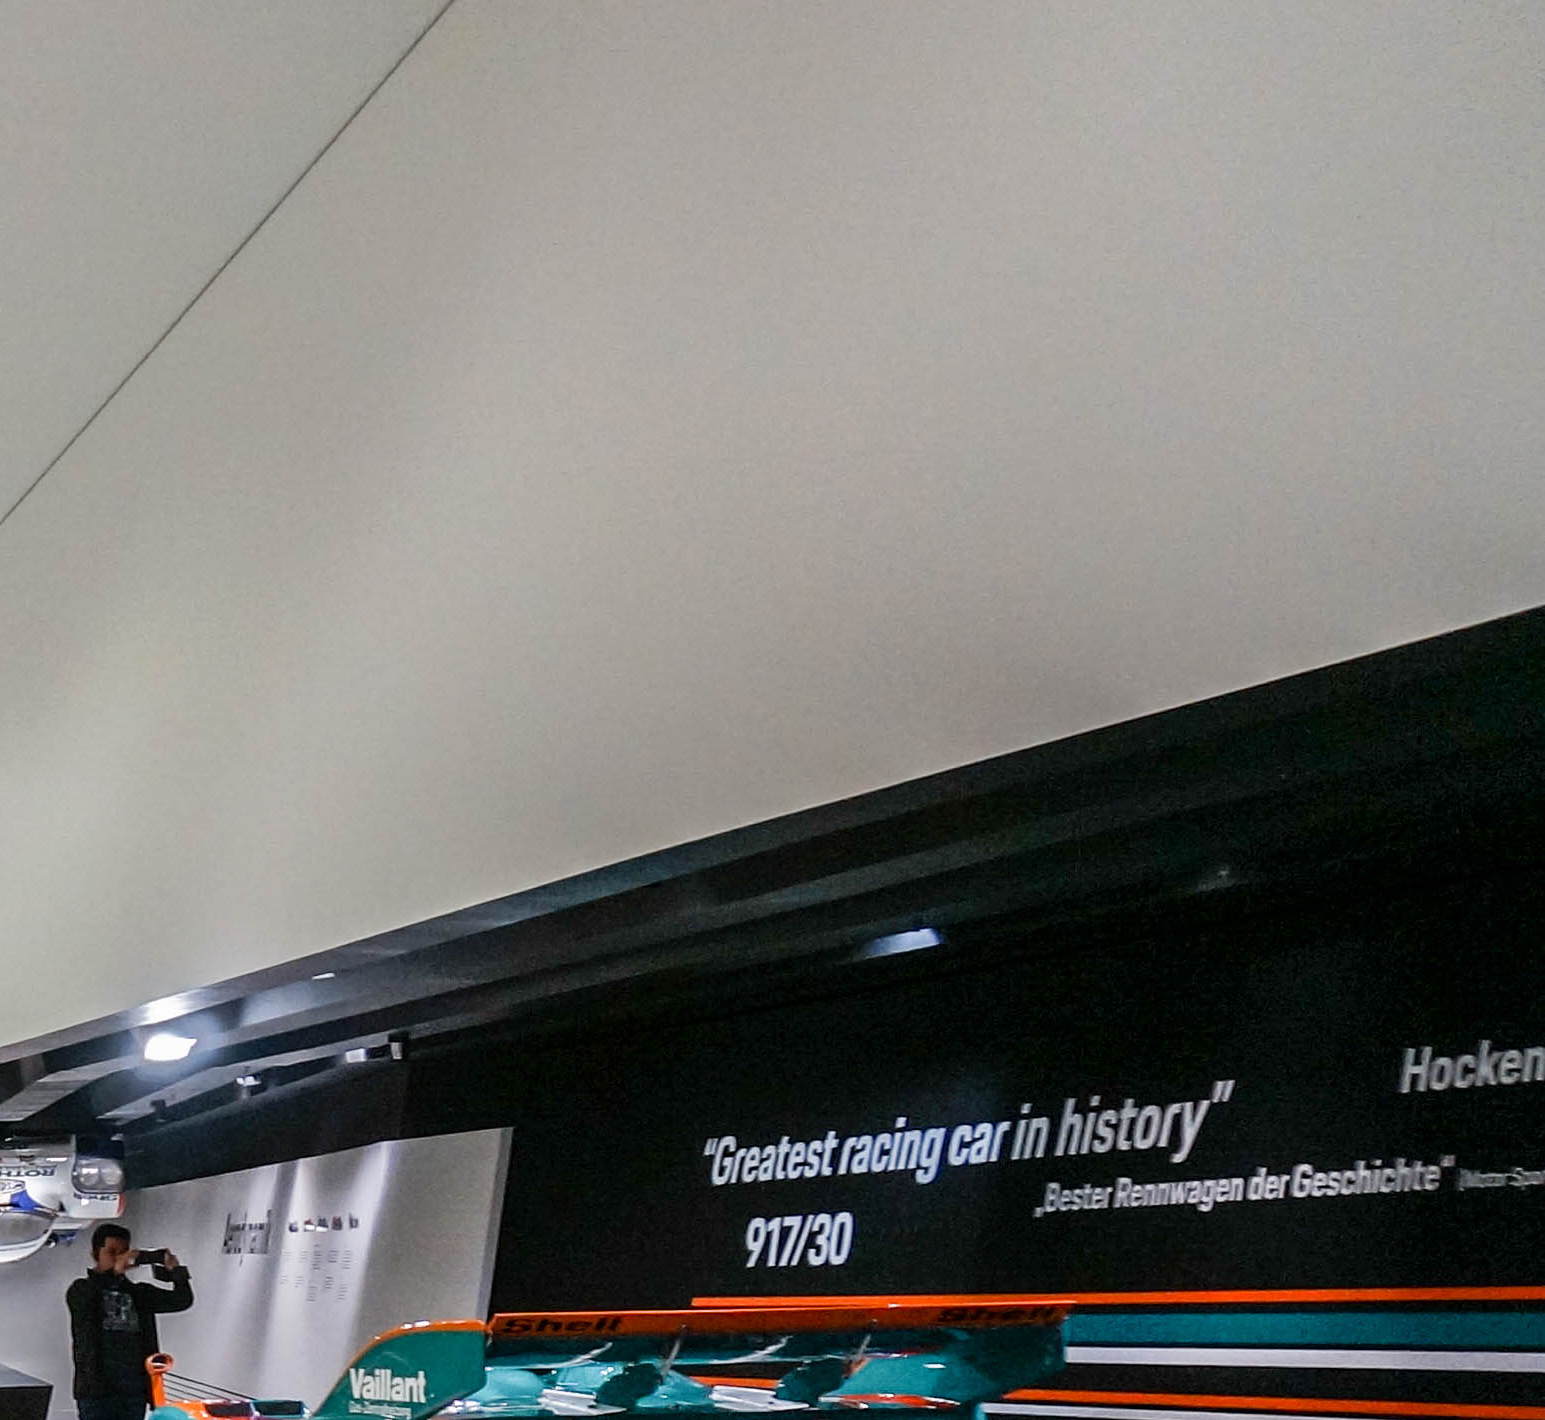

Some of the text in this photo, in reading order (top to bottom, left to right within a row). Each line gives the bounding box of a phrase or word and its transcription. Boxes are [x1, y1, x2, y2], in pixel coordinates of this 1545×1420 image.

[839, 1117, 947, 1185] racing
[947, 1119, 1012, 1168] car
[1011, 1103, 1050, 1161] in
[1113, 1177, 1243, 1212] Rennwagen
[1245, 1165, 1290, 1201] der
[746, 1211, 854, 1269] 917/30
[502, 1317, 623, 1334] Shell
[349, 1368, 426, 1403] Vaillant
